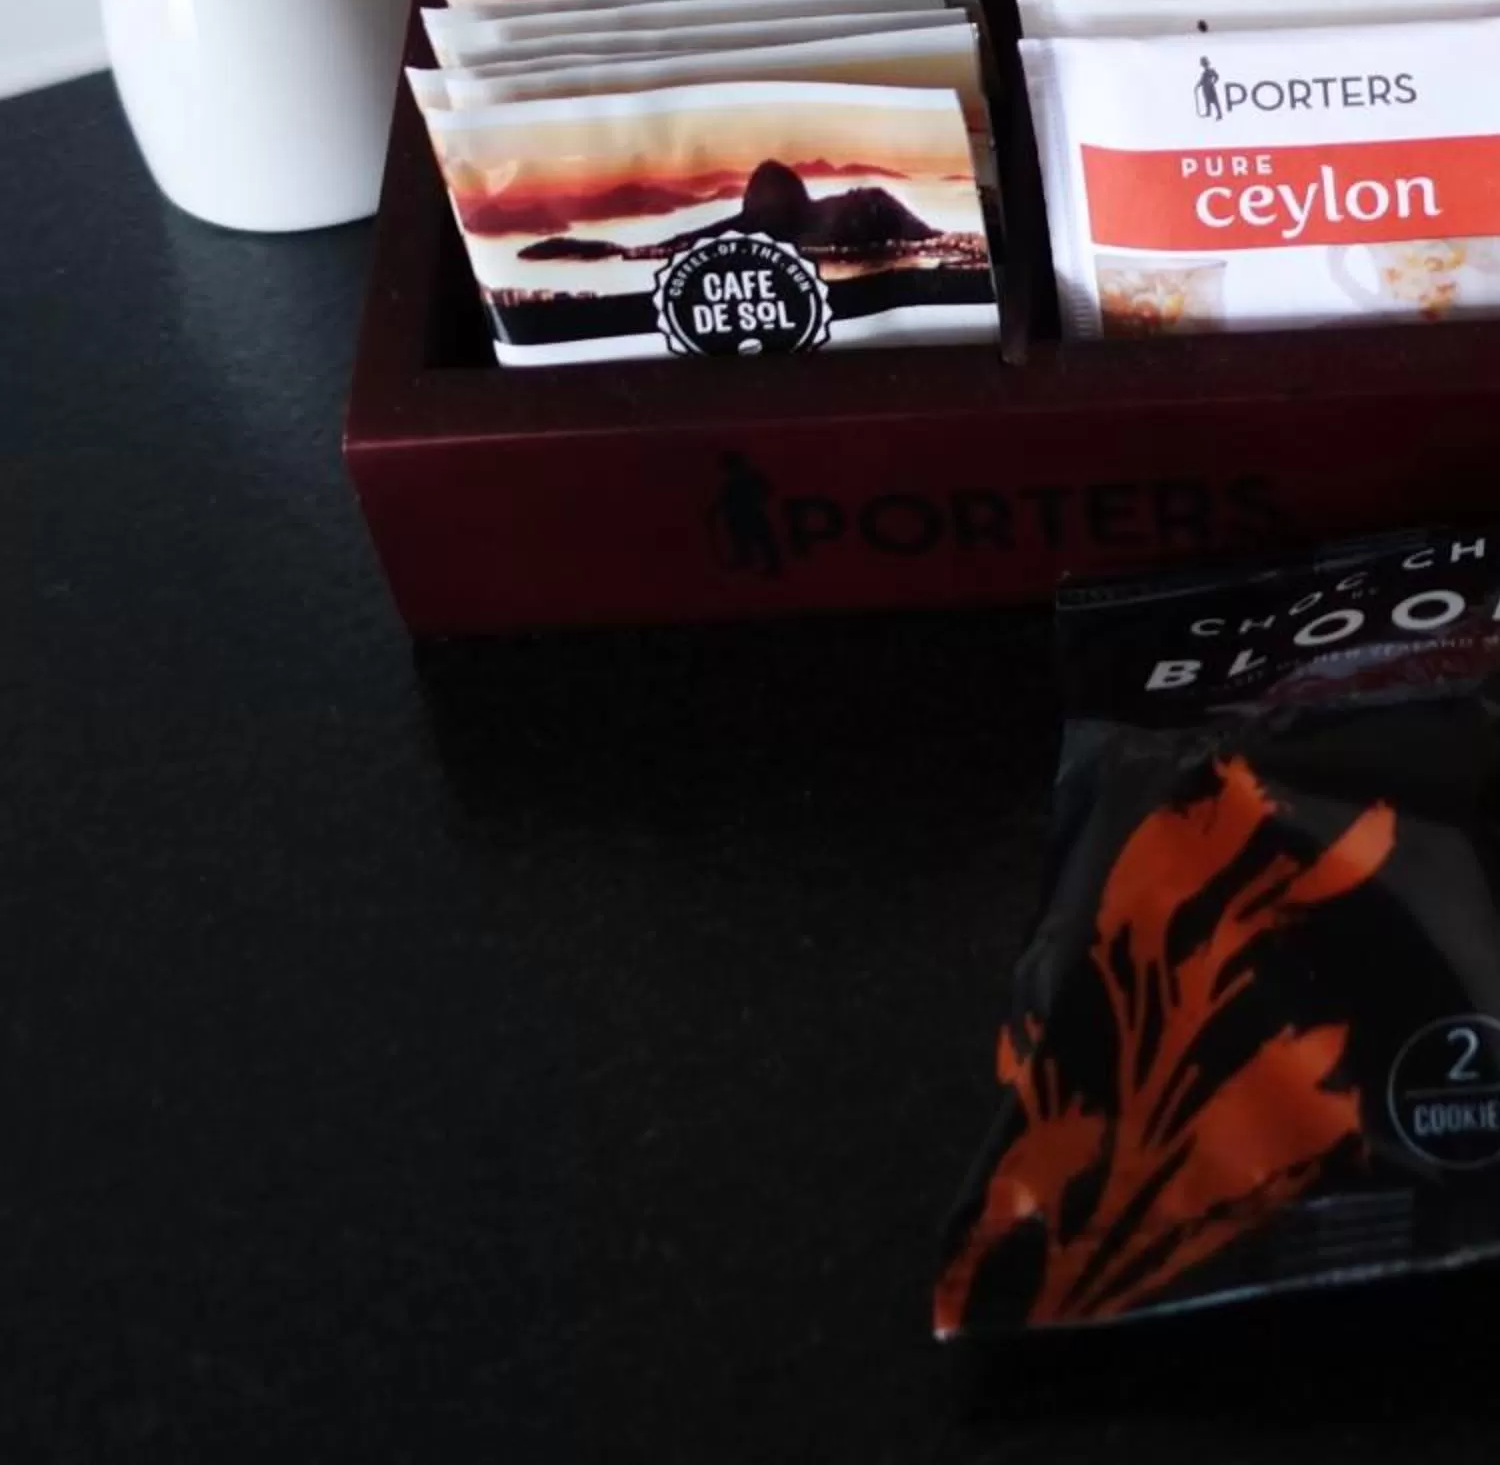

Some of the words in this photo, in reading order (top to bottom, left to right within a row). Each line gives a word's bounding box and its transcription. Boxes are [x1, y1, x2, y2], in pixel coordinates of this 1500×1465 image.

[1224, 73, 1418, 112] PORTERS
[1181, 154, 1274, 177] PURE
[1195, 165, 1444, 239] ceylon
[702, 269, 777, 303] CAFE
[692, 304, 733, 334] DE
[780, 472, 1282, 563] PORTERS
[1190, 571, 1369, 636] CHOC
[1446, 1026, 1480, 1082] 2
